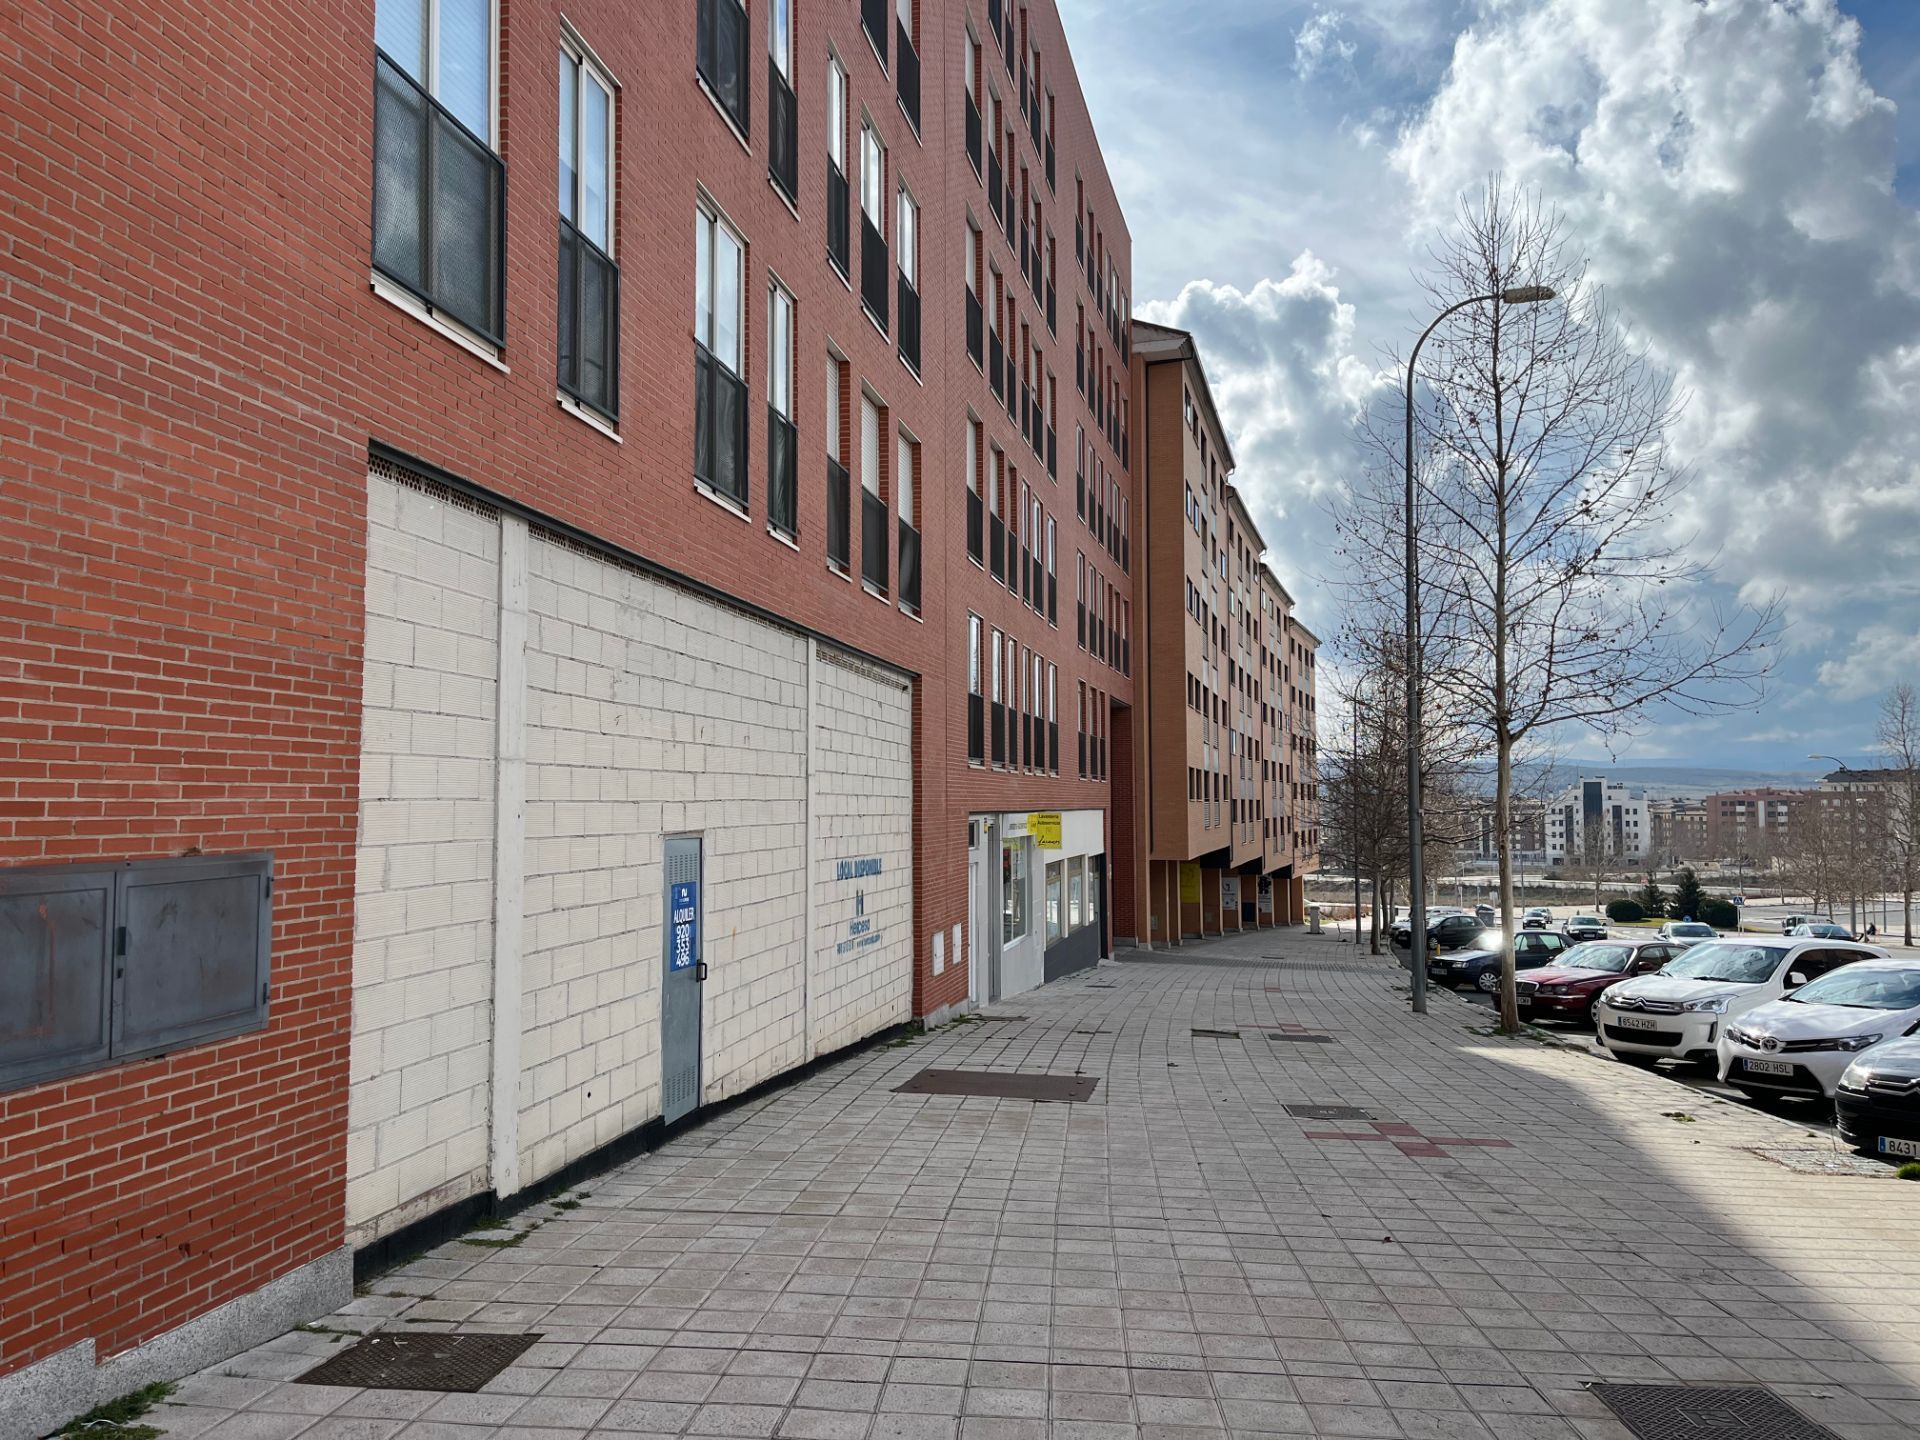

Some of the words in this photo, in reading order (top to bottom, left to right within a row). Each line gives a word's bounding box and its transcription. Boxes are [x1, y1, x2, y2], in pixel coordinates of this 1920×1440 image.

[673, 907, 694, 924] ALQUILER
[676, 924, 690, 940] 920
[676, 938, 690, 954] 353
[1622, 1018, 1640, 1028] 6542
[1748, 1061, 1770, 1072] 2802
[1772, 1063, 1790, 1074] HSL
[1888, 1140, 1917, 1156] 8431
